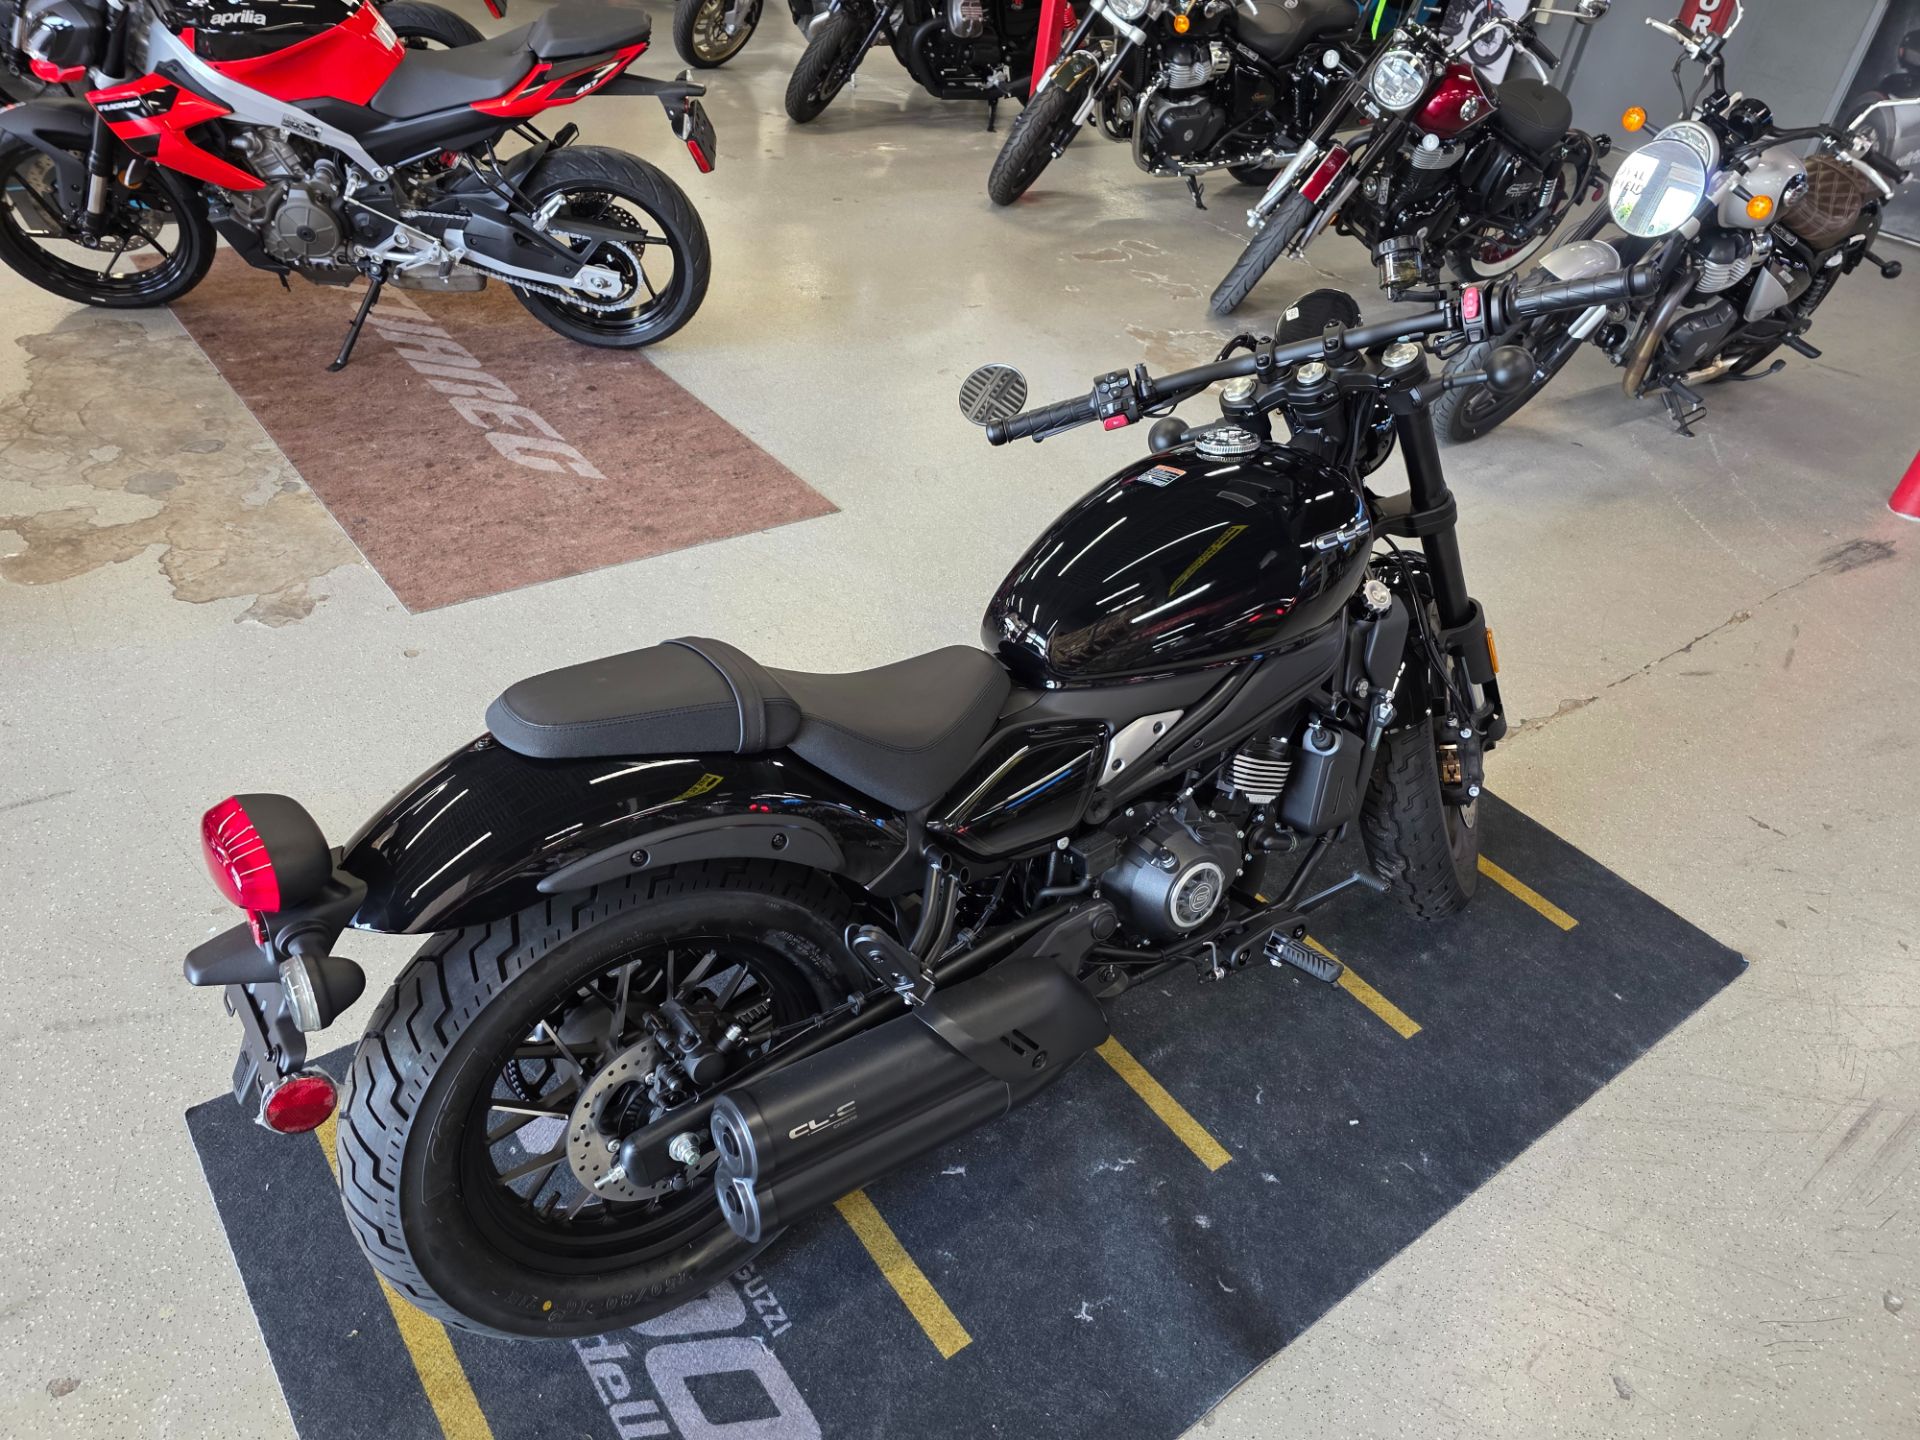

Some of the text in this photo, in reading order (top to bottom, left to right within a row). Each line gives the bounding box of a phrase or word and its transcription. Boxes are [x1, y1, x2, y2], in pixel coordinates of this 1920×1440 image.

[210, 9, 267, 26] aprilia
[98, 99, 141, 112] TUONO
[734, 1261, 793, 1338] GUZZI
